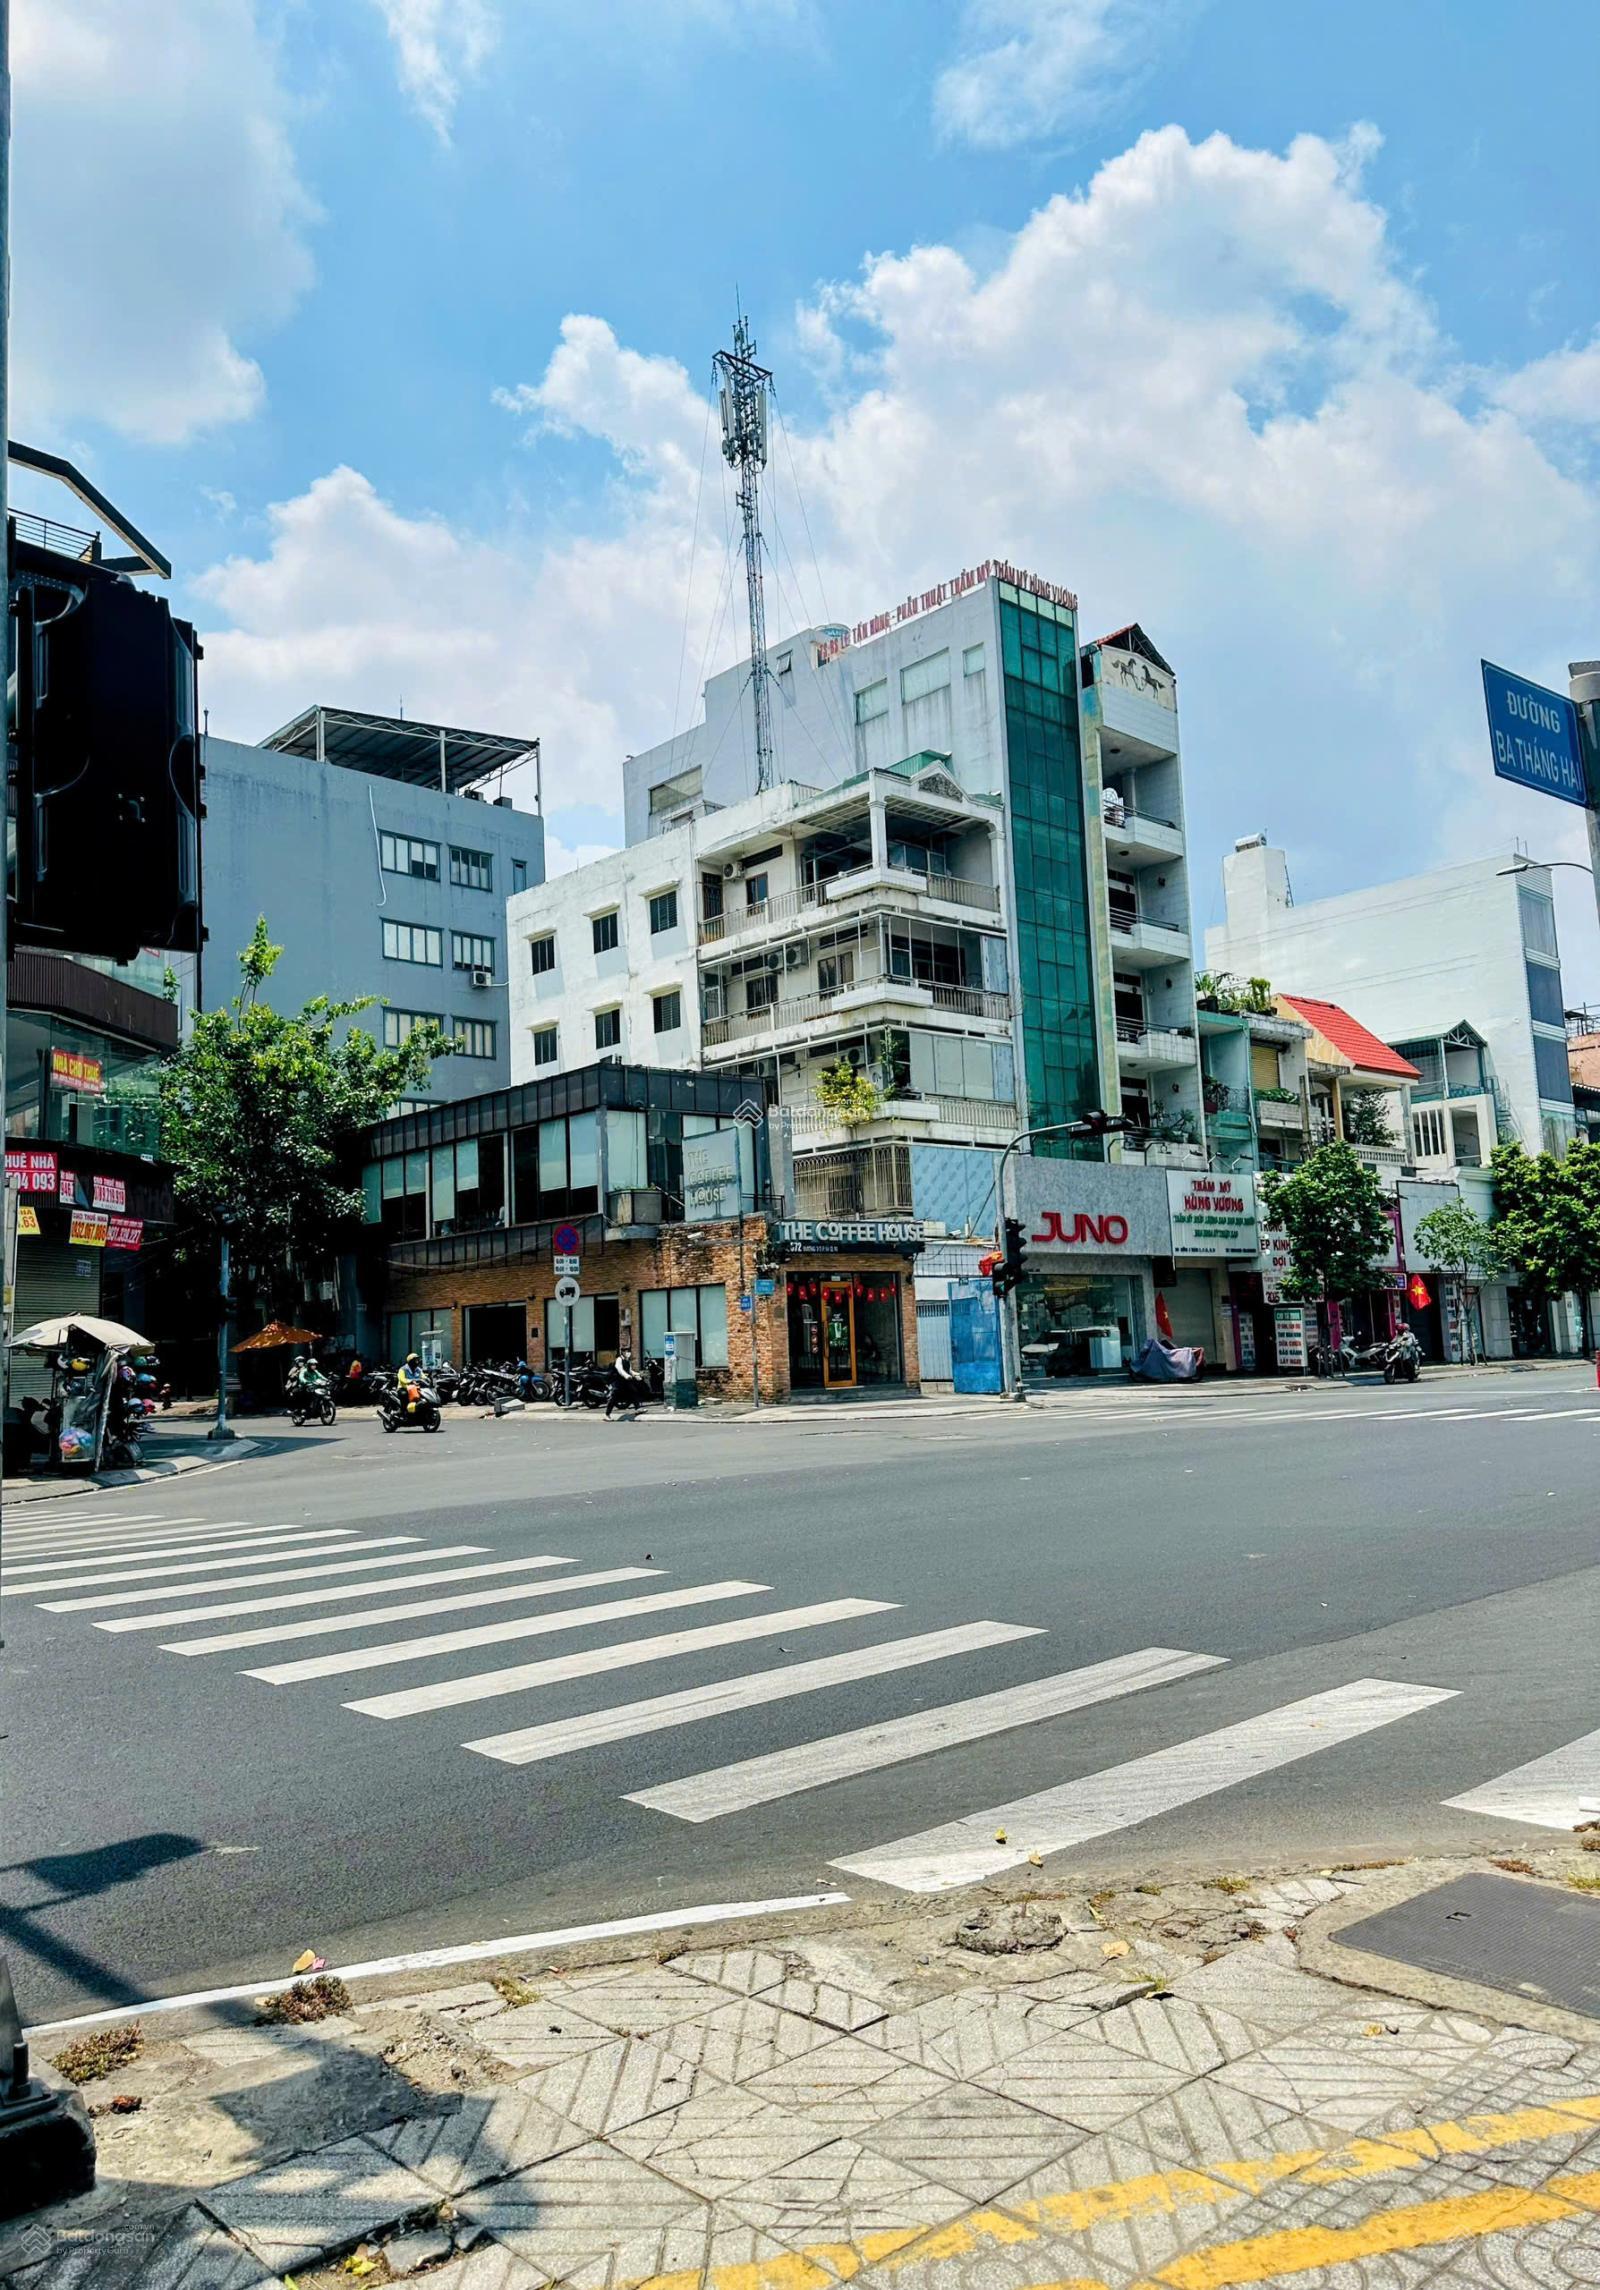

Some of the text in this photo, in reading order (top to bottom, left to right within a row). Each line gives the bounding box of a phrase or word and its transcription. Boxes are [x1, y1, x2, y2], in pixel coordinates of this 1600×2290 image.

[1029, 573, 1050, 598] HÙNG
[1051, 585, 1078, 611] VƯƠNG
[1506, 690, 1561, 734] ĐƯỜNG
[1495, 729, 1582, 792] BA THÁNG HAI
[31, 1153, 55, 1169] NHÀ
[32, 1172, 55, 1190] 093
[689, 1184, 728, 1208] HOUSE
[781, 1221, 813, 1240] THE
[1032, 1211, 1128, 1244] JUNO
